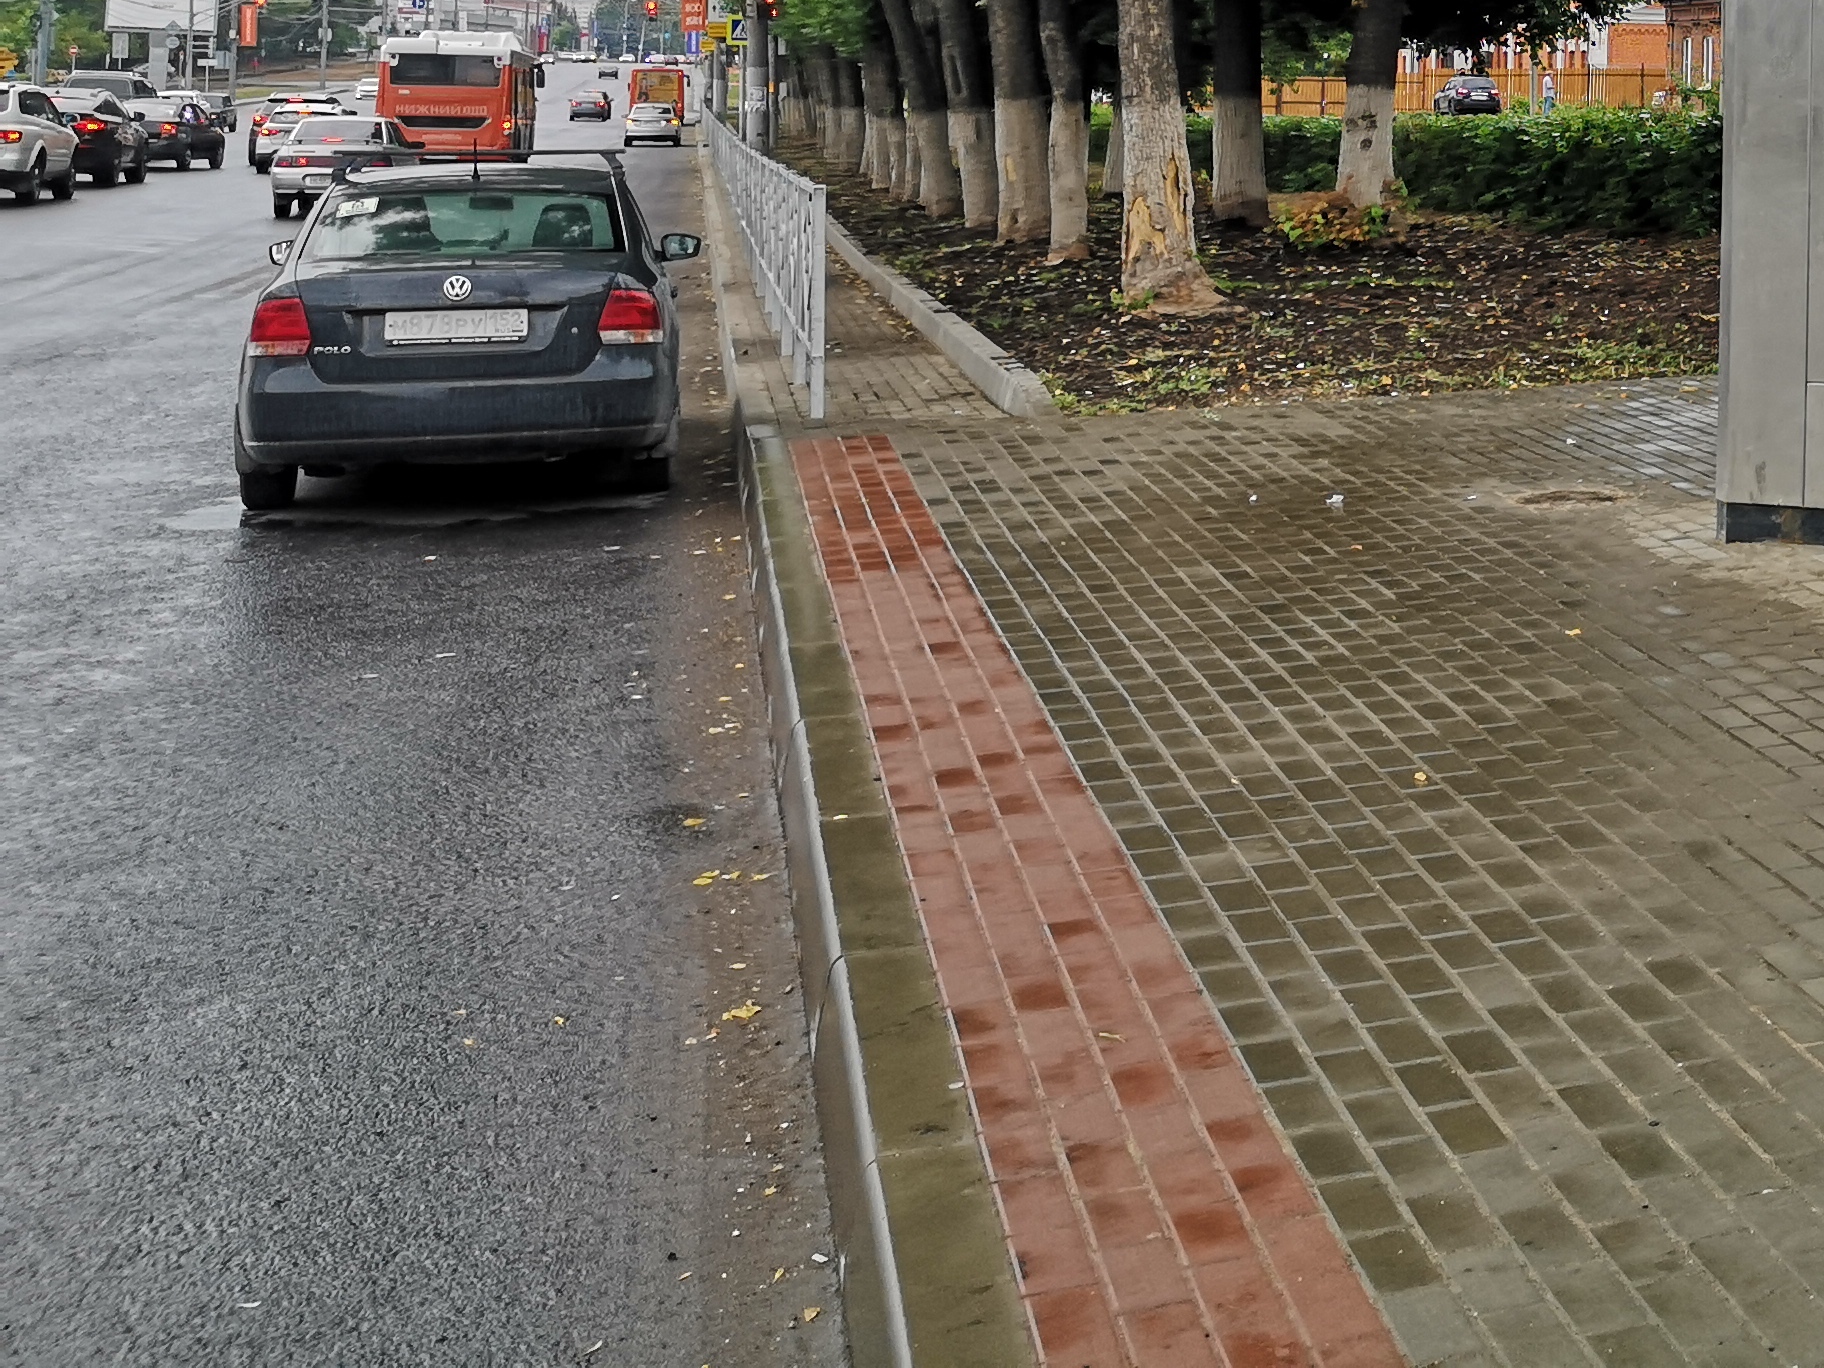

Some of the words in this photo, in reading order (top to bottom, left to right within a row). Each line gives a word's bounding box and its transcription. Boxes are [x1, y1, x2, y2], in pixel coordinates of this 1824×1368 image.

[395, 103, 461, 115] НИЖНИЙ
[488, 311, 522, 329] 152
[313, 345, 352, 355] POLO
